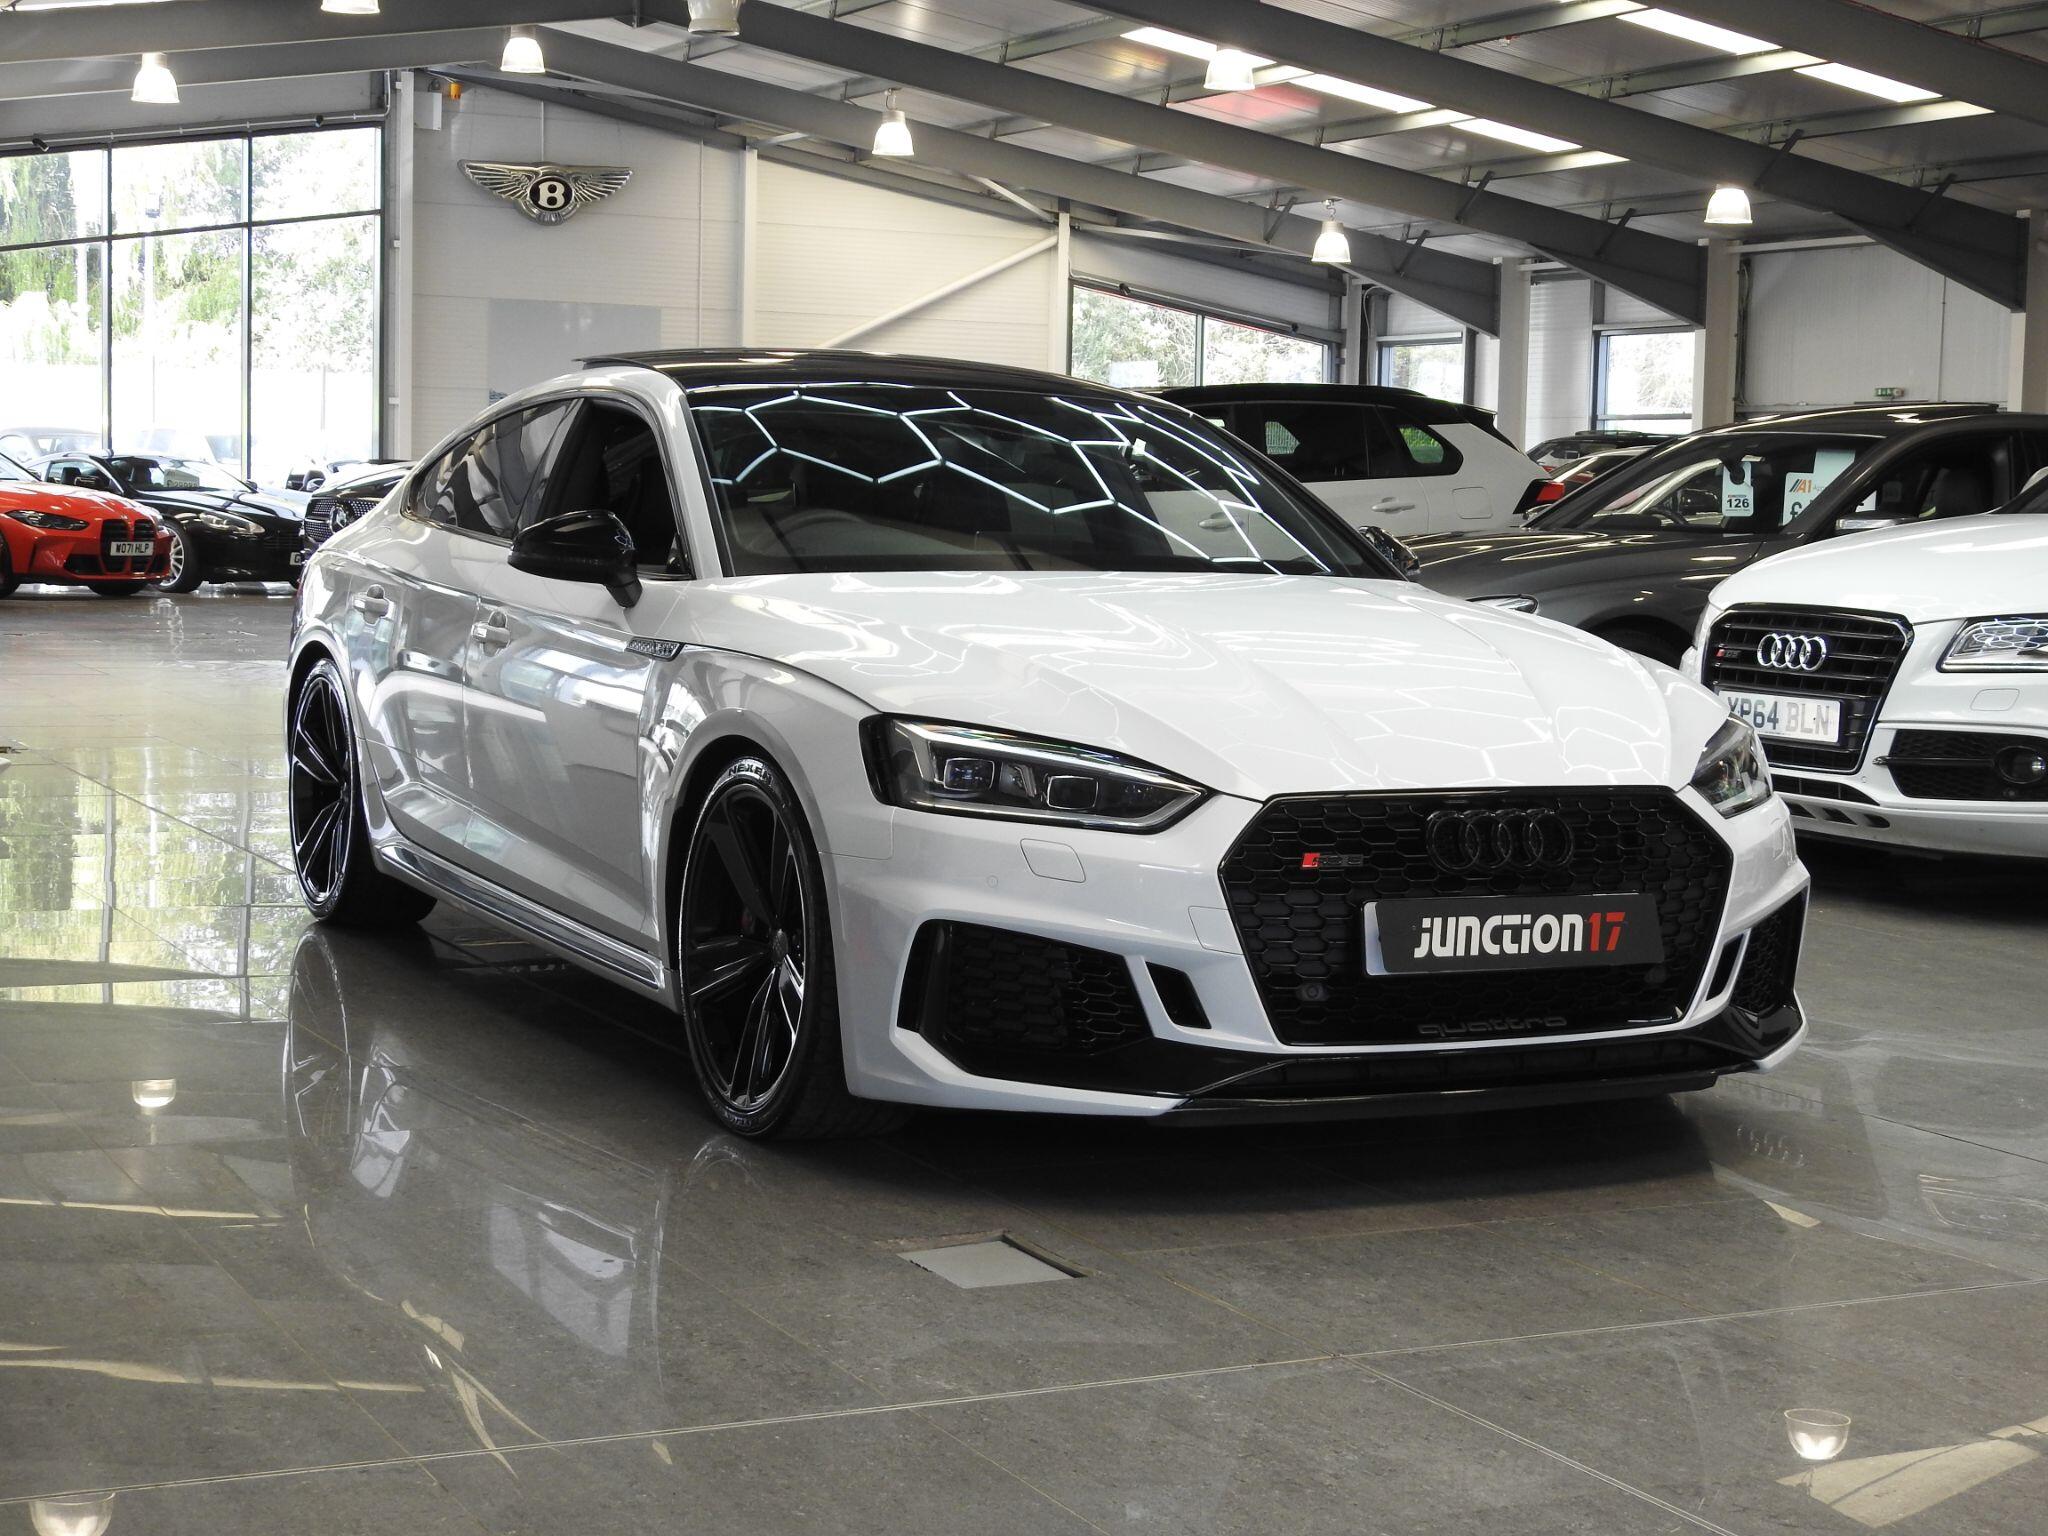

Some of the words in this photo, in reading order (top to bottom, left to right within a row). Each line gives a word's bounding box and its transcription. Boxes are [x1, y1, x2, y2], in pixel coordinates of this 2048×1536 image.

[538, 181, 565, 209] B
[1727, 498, 1750, 508] 126
[1785, 702, 1830, 735] BLN
[728, 763, 773, 784] NEXEN
[1416, 1016, 1568, 1038] quattro
